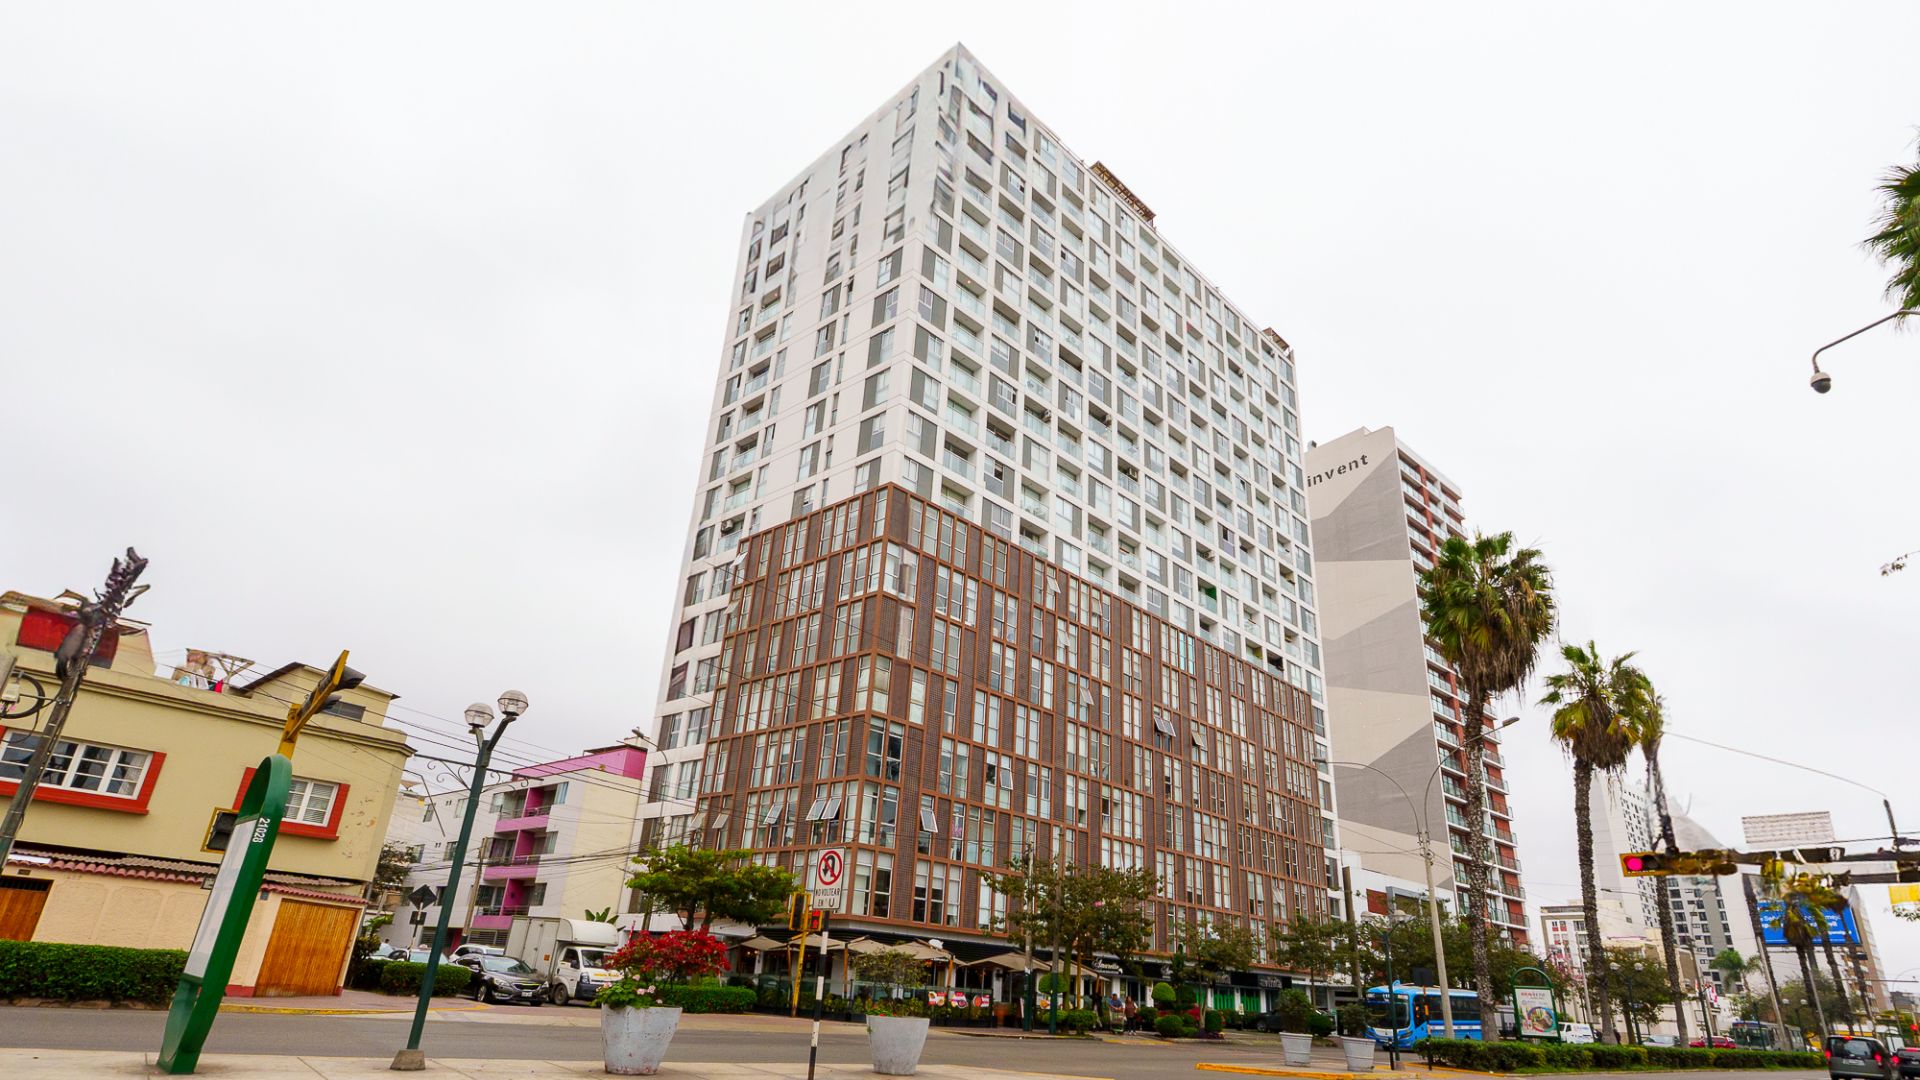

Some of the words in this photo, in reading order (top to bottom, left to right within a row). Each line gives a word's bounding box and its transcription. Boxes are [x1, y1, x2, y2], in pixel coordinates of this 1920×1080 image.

[1307, 454, 1368, 487] invent
[252, 817, 270, 842] 21028
[821, 887, 840, 897] VOLTEAR
